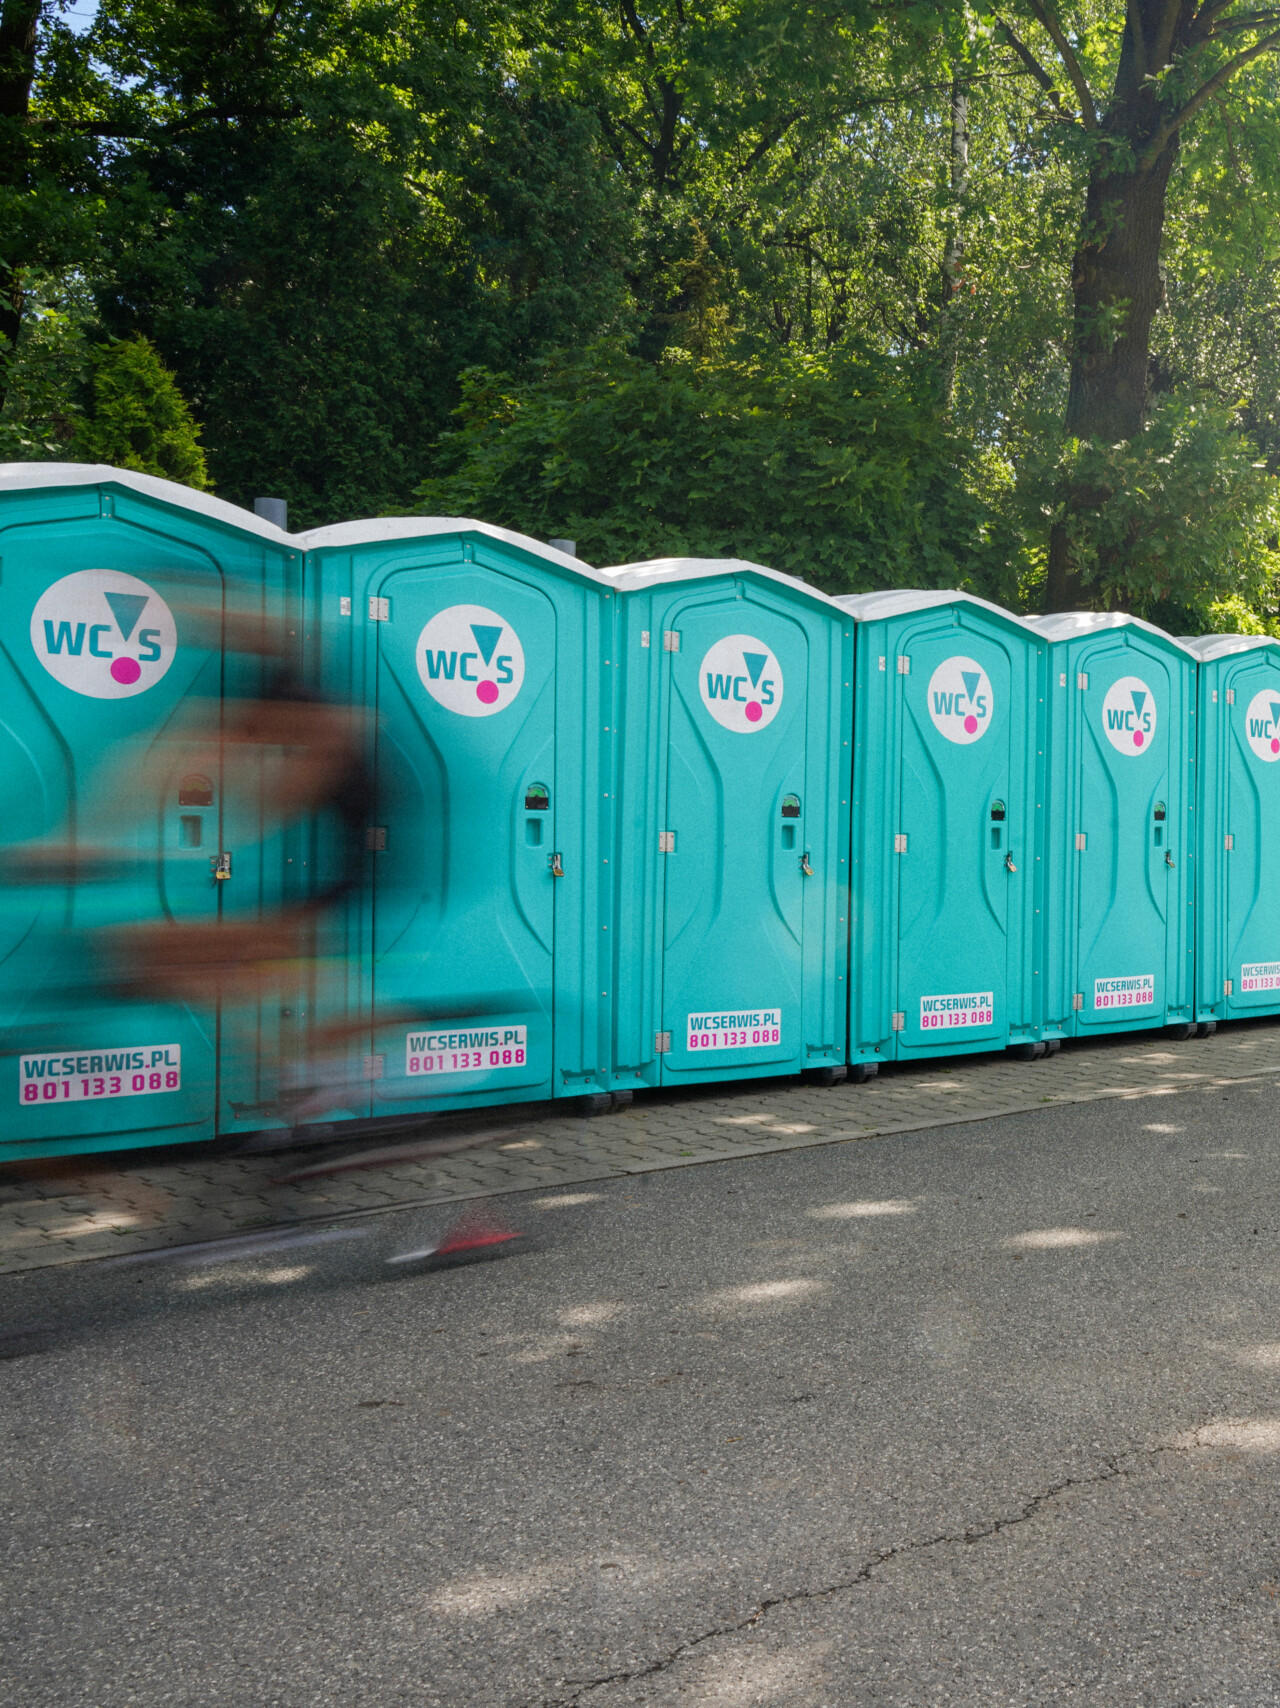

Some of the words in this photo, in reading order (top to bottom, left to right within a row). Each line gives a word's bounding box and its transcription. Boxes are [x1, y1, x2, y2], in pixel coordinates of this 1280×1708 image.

[1097, 979, 1152, 993] WCSERWIS.PL
[1243, 979, 1257, 990] 801
[1261, 978, 1273, 988] 133
[923, 996, 991, 1012] WCSERWIS.PL
[1096, 995, 1114, 1007] 801
[1118, 994, 1132, 1005] 133
[1136, 992, 1152, 1003] 088
[690, 1013, 779, 1031] WCSERWIS.PL
[922, 1015, 943, 1028] 801
[949, 1013, 966, 1025] 133
[971, 1011, 991, 1024] 088
[411, 1030, 524, 1053] WCSERWIS.PL
[690, 1034, 717, 1048] 801
[723, 1032, 747, 1046] 133
[753, 1029, 779, 1043] 088
[26, 1050, 178, 1079] WCSERWIS.PL
[410, 1056, 443, 1072] 801
[452, 1052, 481, 1068] 133
[490, 1049, 524, 1066] 088
[25, 1081, 71, 1102] 801
[82, 1077, 121, 1097] 133
[132, 1071, 178, 1092] 088
